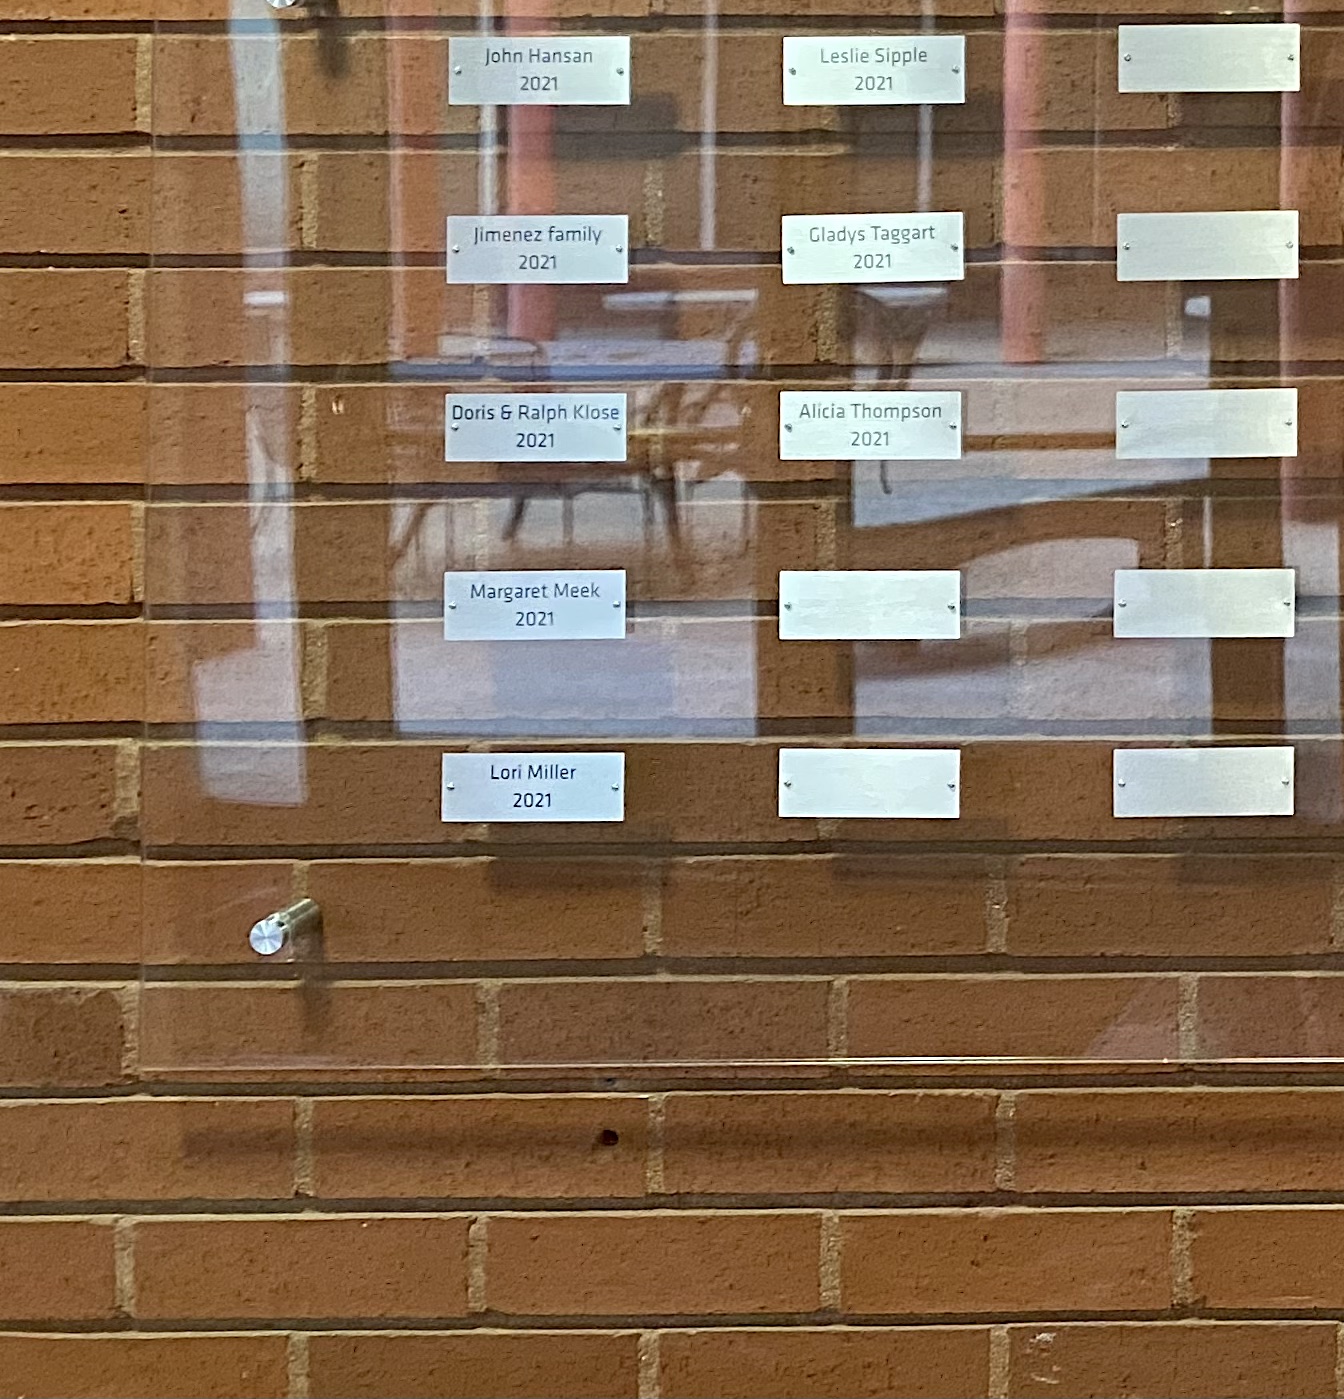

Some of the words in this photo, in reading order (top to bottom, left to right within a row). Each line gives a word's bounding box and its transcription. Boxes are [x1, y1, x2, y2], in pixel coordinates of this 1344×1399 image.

[484, 47, 523, 67] John
[528, 48, 593, 64] Hansan
[820, 47, 870, 64] Leslie
[875, 46, 928, 67] Sipple
[520, 75, 558, 91] 2021
[854, 75, 893, 91] 2021
[473, 227, 543, 246] Jimenez
[547, 225, 602, 246] family
[809, 225, 866, 246] Gladys
[870, 225, 936, 245] Taggart
[518, 254, 557, 270] 2021
[853, 253, 891, 269] 2021
[452, 404, 495, 421] Doris
[500, 404, 513, 420] &
[518, 404, 567, 424] Ralph
[573, 404, 620, 420] Klose
[799, 403, 845, 419] Alicia
[850, 403, 942, 422] Thompson
[516, 432, 554, 448] 2021
[851, 431, 889, 447] 2021
[470, 583, 548, 603] Margaret
[553, 582, 601, 598] Meek
[515, 611, 554, 627] 2021
[490, 764, 522, 780] Lori
[527, 764, 577, 780] Miller
[513, 792, 551, 808] 2021
